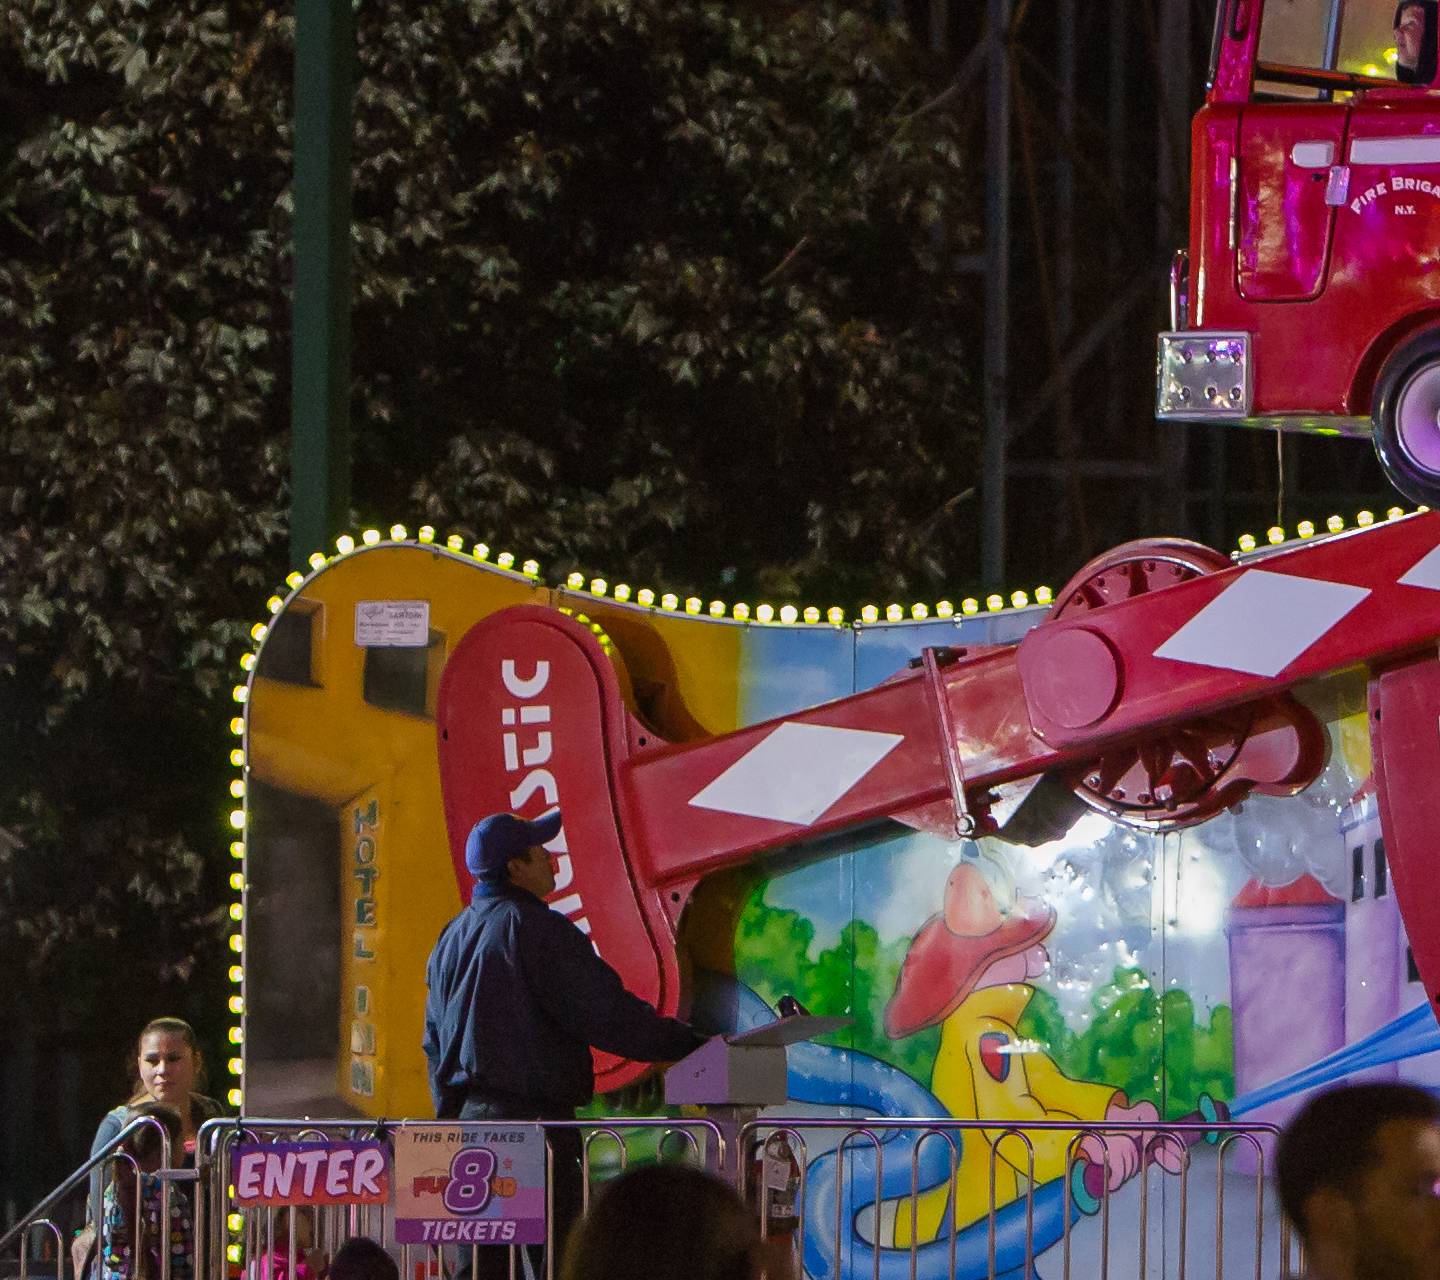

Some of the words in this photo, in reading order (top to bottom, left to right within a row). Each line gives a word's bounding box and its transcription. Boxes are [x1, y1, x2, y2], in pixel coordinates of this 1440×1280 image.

[1350, 181, 1388, 216] FIRE
[412, 1131, 443, 1144] THIS
[446, 1131, 479, 1144] RIDE
[483, 1131, 527, 1144] TAKES
[237, 1147, 386, 1200] ENTER
[442, 1146, 499, 1216] 8
[421, 1220, 516, 1242] TICKETS
